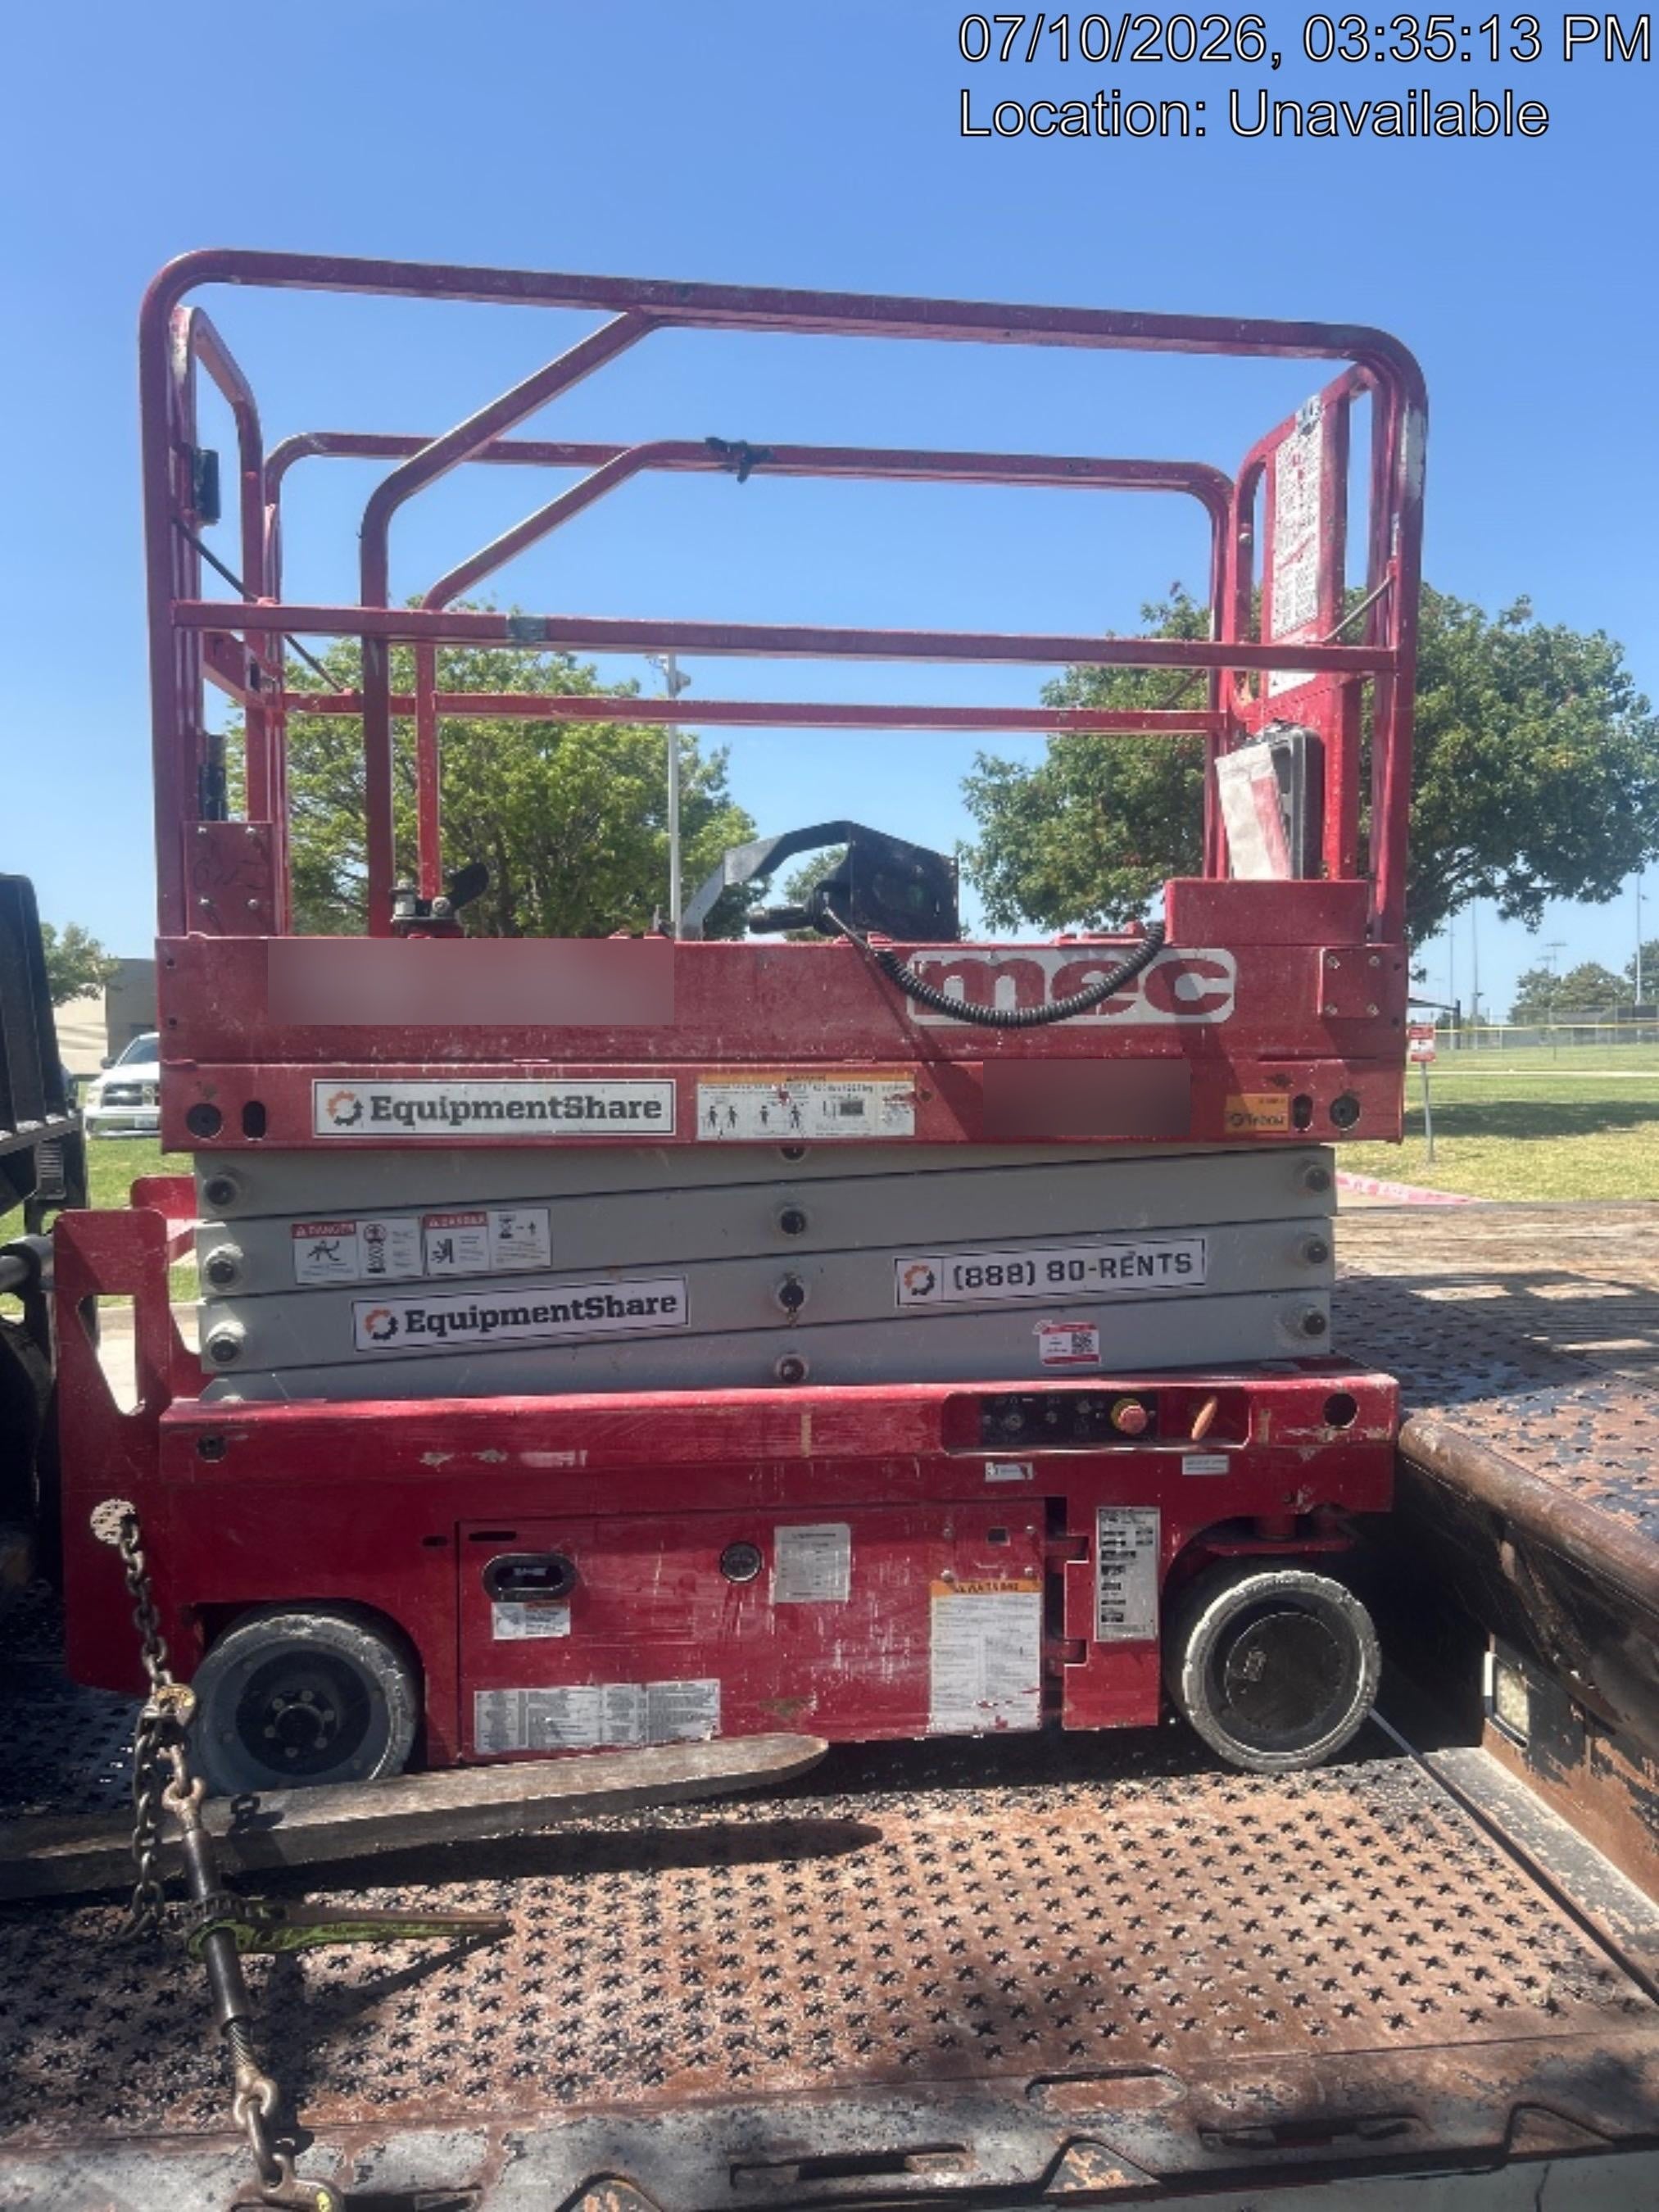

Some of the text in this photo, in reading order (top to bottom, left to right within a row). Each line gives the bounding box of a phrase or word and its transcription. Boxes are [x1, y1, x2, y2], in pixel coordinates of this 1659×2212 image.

[370, 1095, 662, 1126] EquipmentShare
[953, 1252, 1193, 1291] (888) 80-RENTS
[404, 1294, 678, 1337] EquipmentShare
